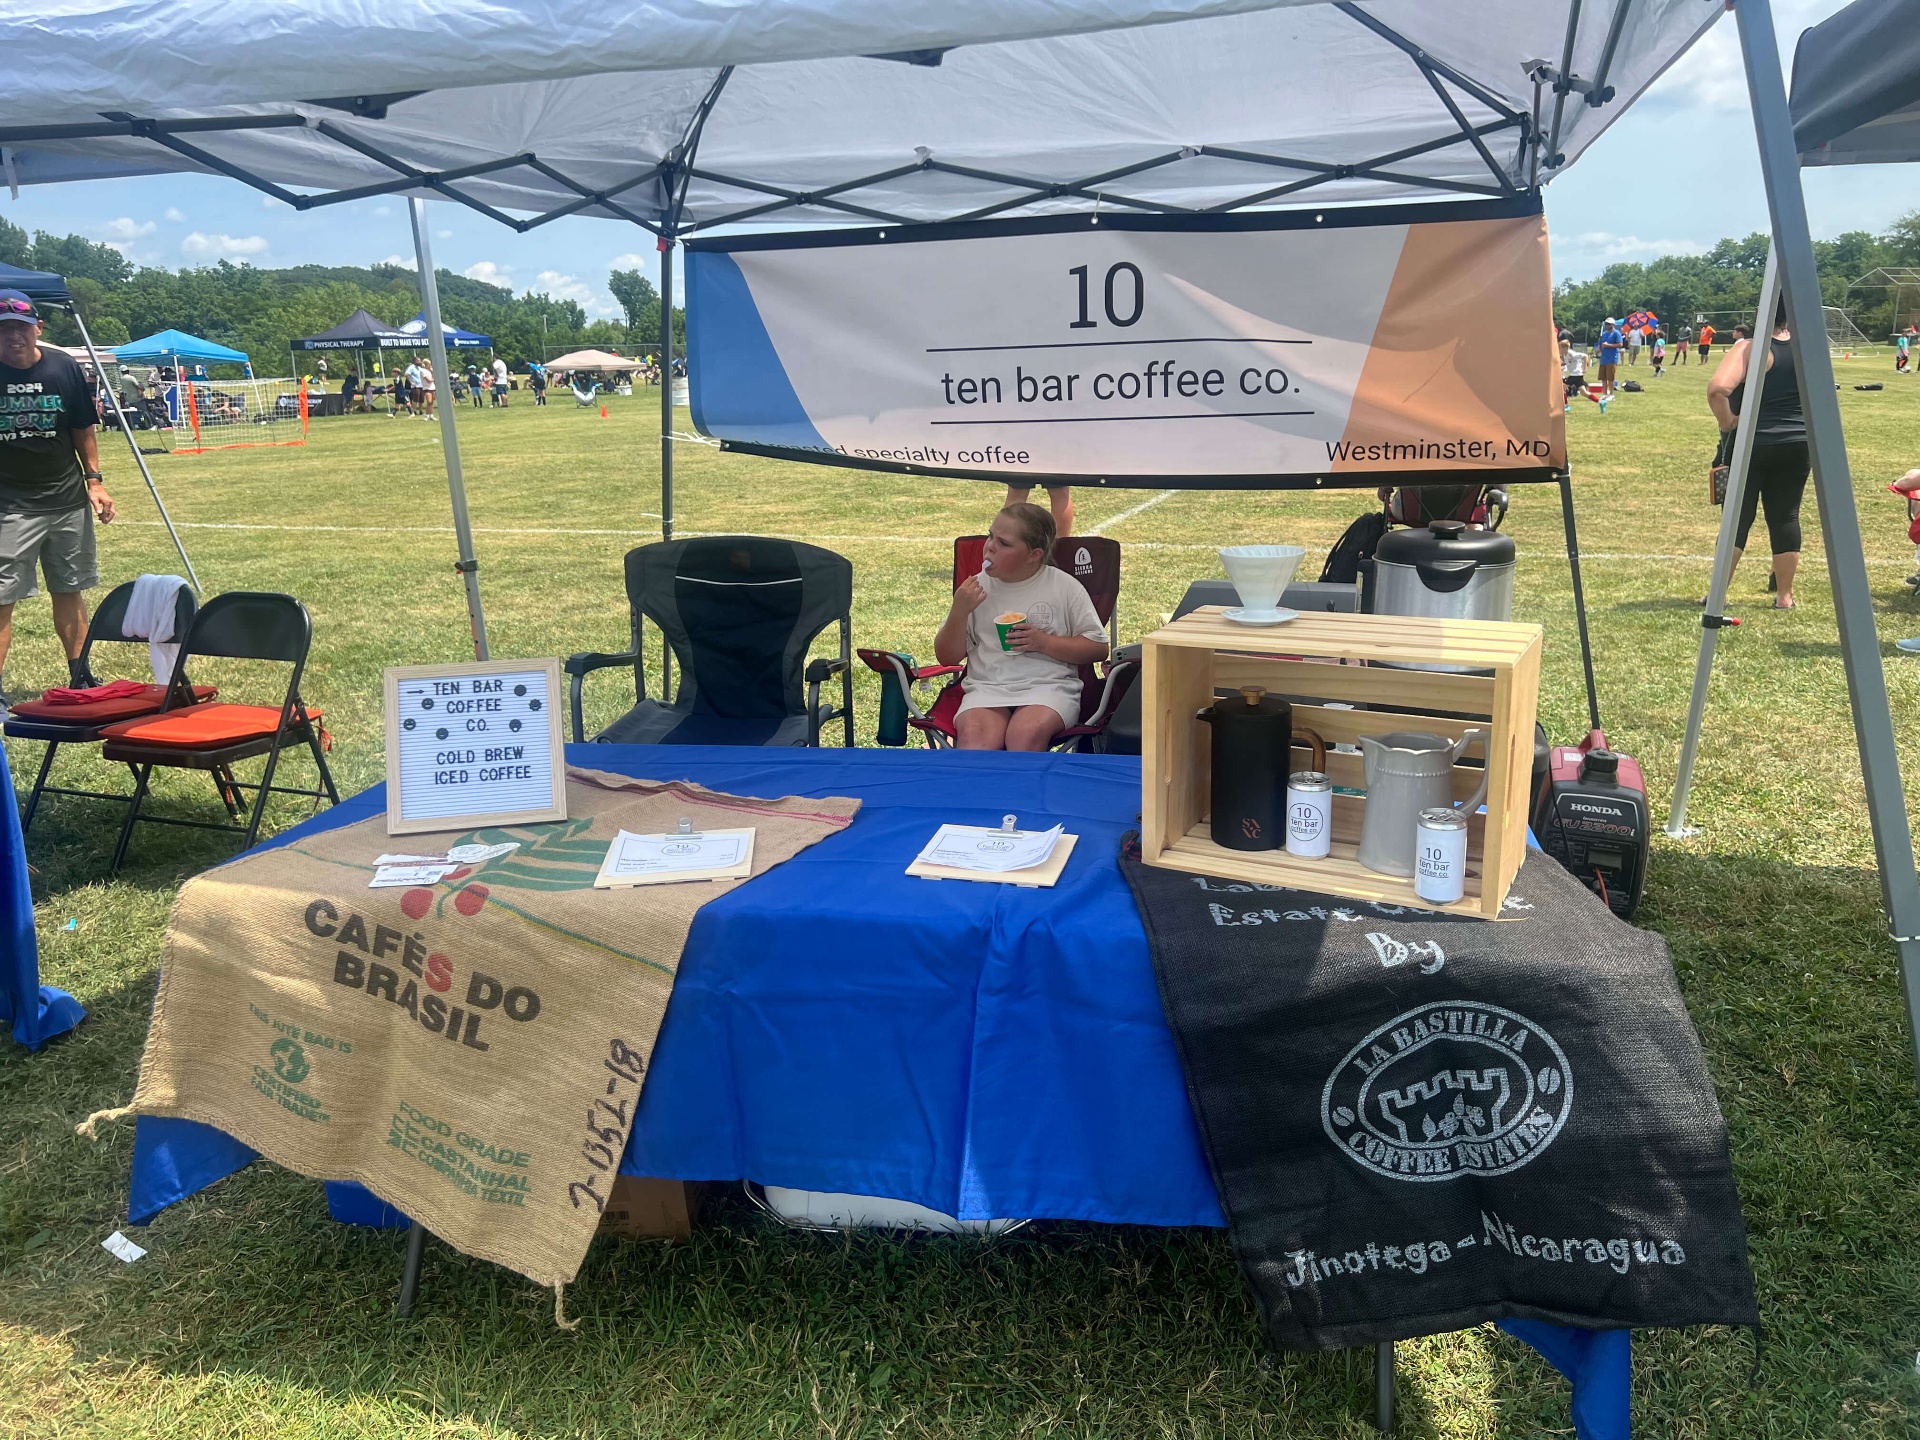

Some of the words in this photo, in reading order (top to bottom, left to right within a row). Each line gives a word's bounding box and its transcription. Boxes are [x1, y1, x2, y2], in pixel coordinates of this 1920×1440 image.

[1069, 261, 1144, 329] 10
[7, 383, 43, 393] 2024
[941, 373, 1002, 404] ten
[1016, 366, 1080, 402] bar
[1093, 360, 1224, 400] coffee
[1239, 367, 1300, 395] co.
[0, 395, 66, 413] UMMER
[19, 430, 57, 438] SOCCER
[854, 446, 949, 467] specialty
[957, 446, 1030, 465] coffee
[1326, 439, 1496, 462] Westminster,
[1505, 438, 1551, 458] MD
[433, 681, 460, 696] TEN
[473, 679, 503, 693] BAR
[446, 698, 502, 714] COFFEE
[466, 718, 490, 732] CO.
[436, 750, 475, 765] COLD
[485, 746, 524, 762] BREW
[435, 769, 469, 785] ICED
[479, 765, 532, 782] COFFEE
[1297, 807, 1311, 818] 10
[1570, 803, 1622, 816] HONDA
[1291, 818, 1302, 827] ten
[1304, 819, 1318, 828] bar
[1426, 847, 1442, 860] 10
[1419, 859, 1431, 869] ten
[1433, 861, 1450, 871] bar
[1208, 902, 1363, 927] Estate
[304, 899, 453, 992] CAFÉS
[466, 971, 541, 1022] DO
[1364, 931, 1445, 975] By
[333, 950, 490, 1052] BRASIL
[304, 1031, 335, 1050] BAG
[338, 1040, 353, 1054] IS
[1353, 1044, 1393, 1075] LA
[1391, 1010, 1530, 1052] BASTILLA
[399, 1100, 453, 1138] FOOD
[455, 1131, 531, 1168] GRADE
[1348, 1131, 1452, 1174] COFFEE
[1453, 1105, 1555, 1168] ESTATES
[1285, 1240, 1453, 1288] Jinotega
[1480, 1209, 1687, 1274] Nicaragua
